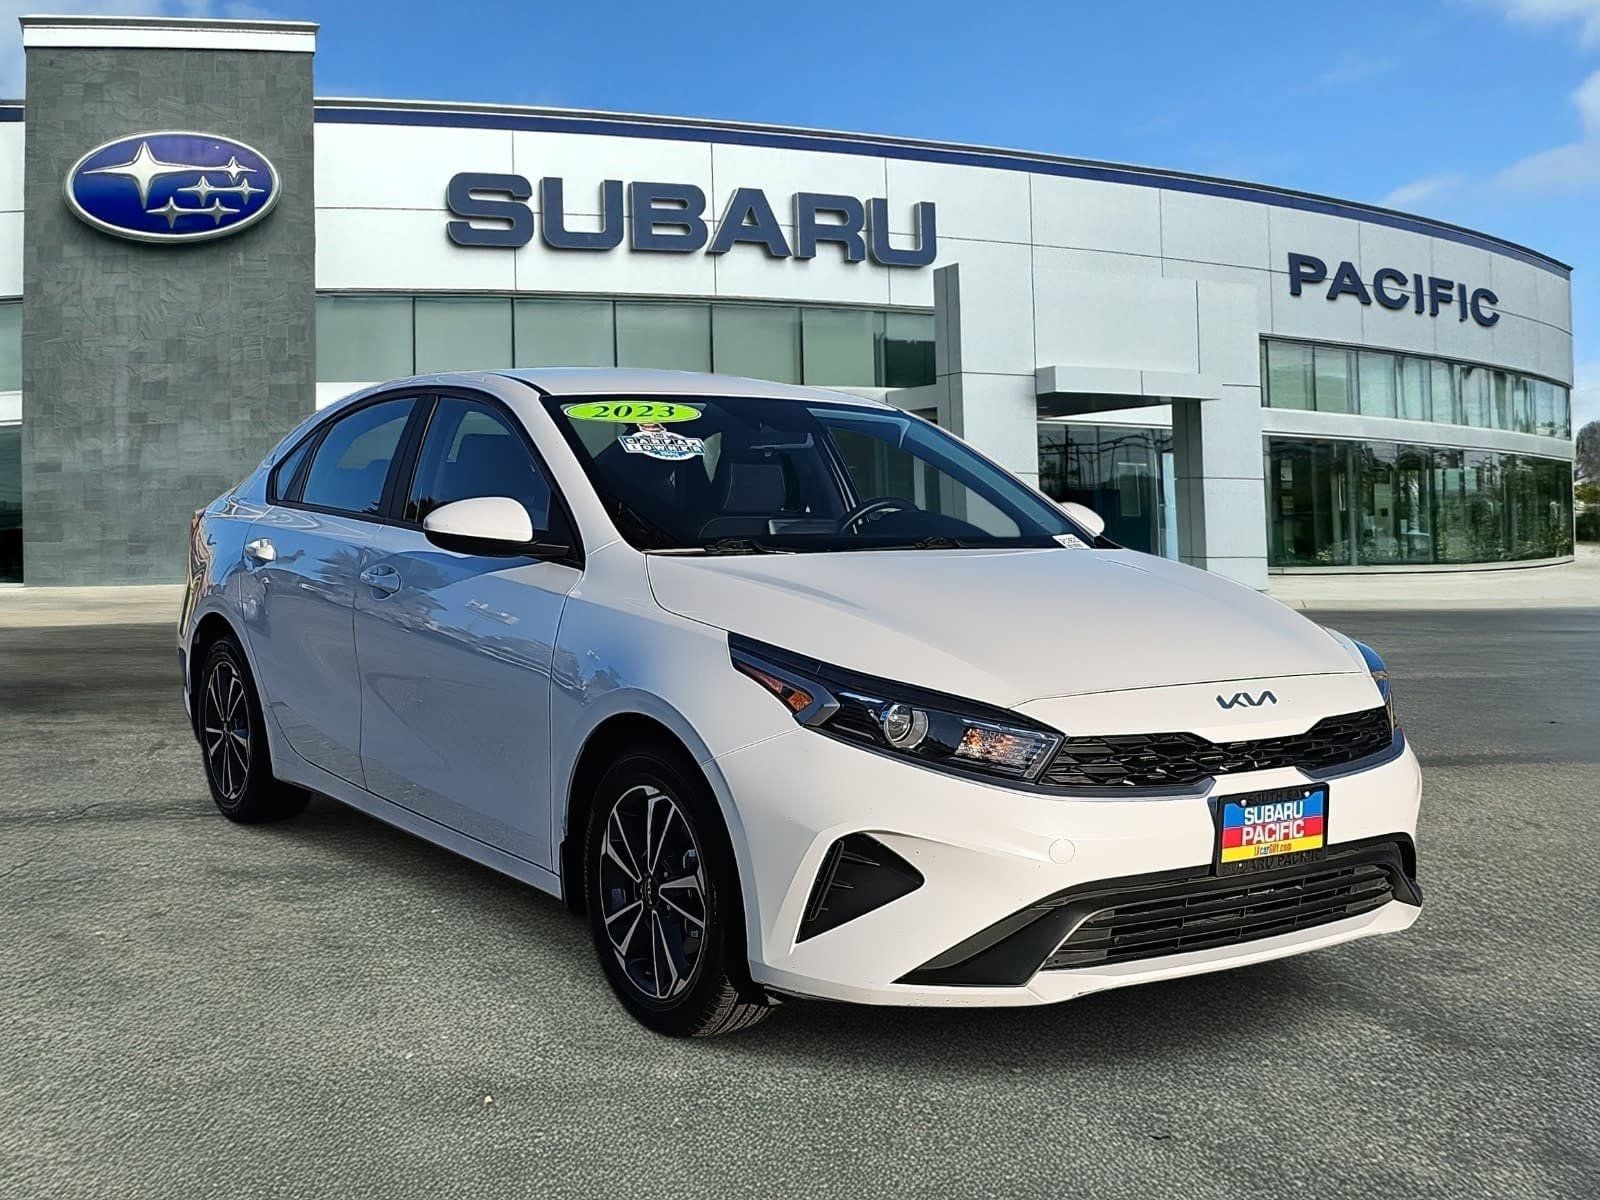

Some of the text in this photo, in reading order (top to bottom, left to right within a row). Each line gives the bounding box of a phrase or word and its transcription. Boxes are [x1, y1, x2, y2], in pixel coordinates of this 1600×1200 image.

[447, 171, 938, 268] SUBARU
[1287, 251, 1501, 327] PACIFIC
[592, 404, 676, 418] 2023
[1216, 690, 1278, 709] KIA
[1244, 800, 1304, 825] SUBARU
[1241, 820, 1305, 846] PACIFIC
